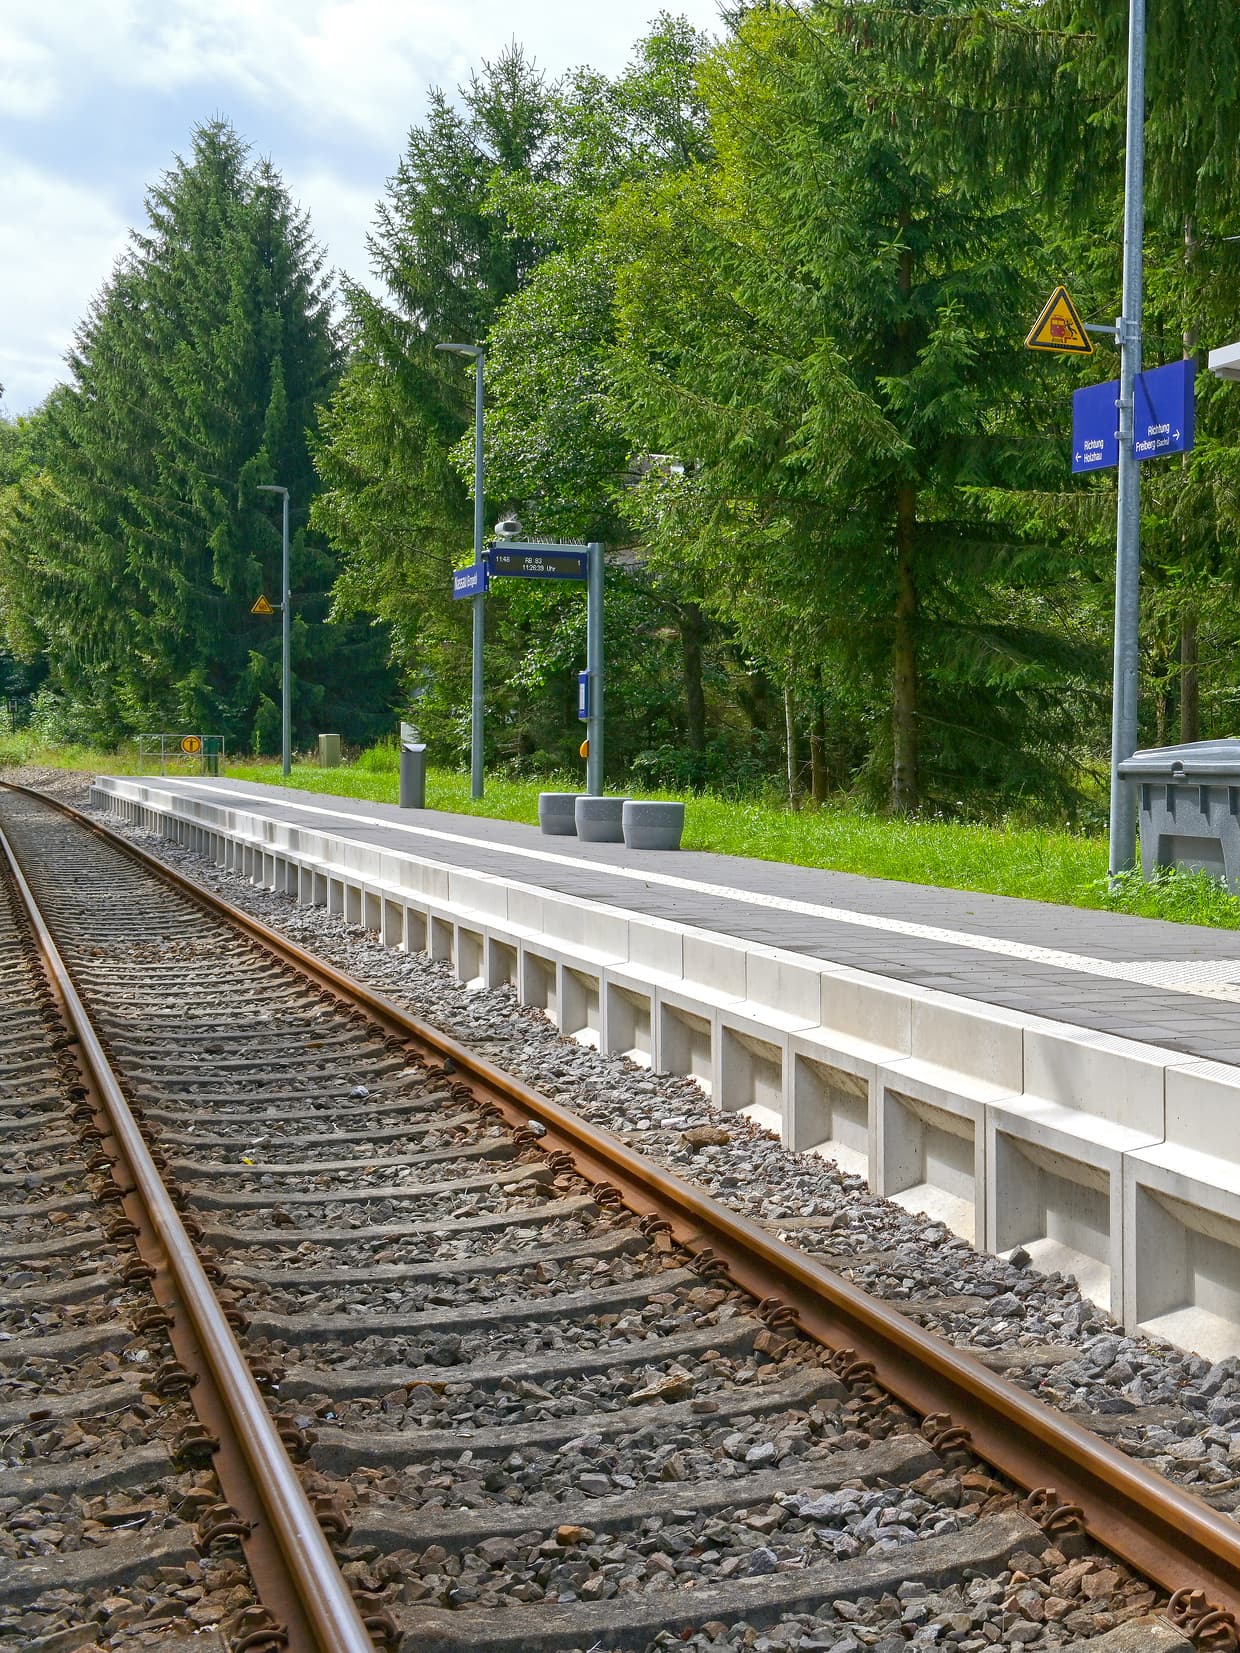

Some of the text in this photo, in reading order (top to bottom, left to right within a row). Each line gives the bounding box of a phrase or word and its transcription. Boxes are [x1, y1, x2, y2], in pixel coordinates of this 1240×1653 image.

[1148, 424, 1170, 436] Richtung
[1084, 439, 1104, 451] Richtung
[1136, 440, 1156, 452] Freiberg
[1083, 451, 1103, 464] Holzhau
